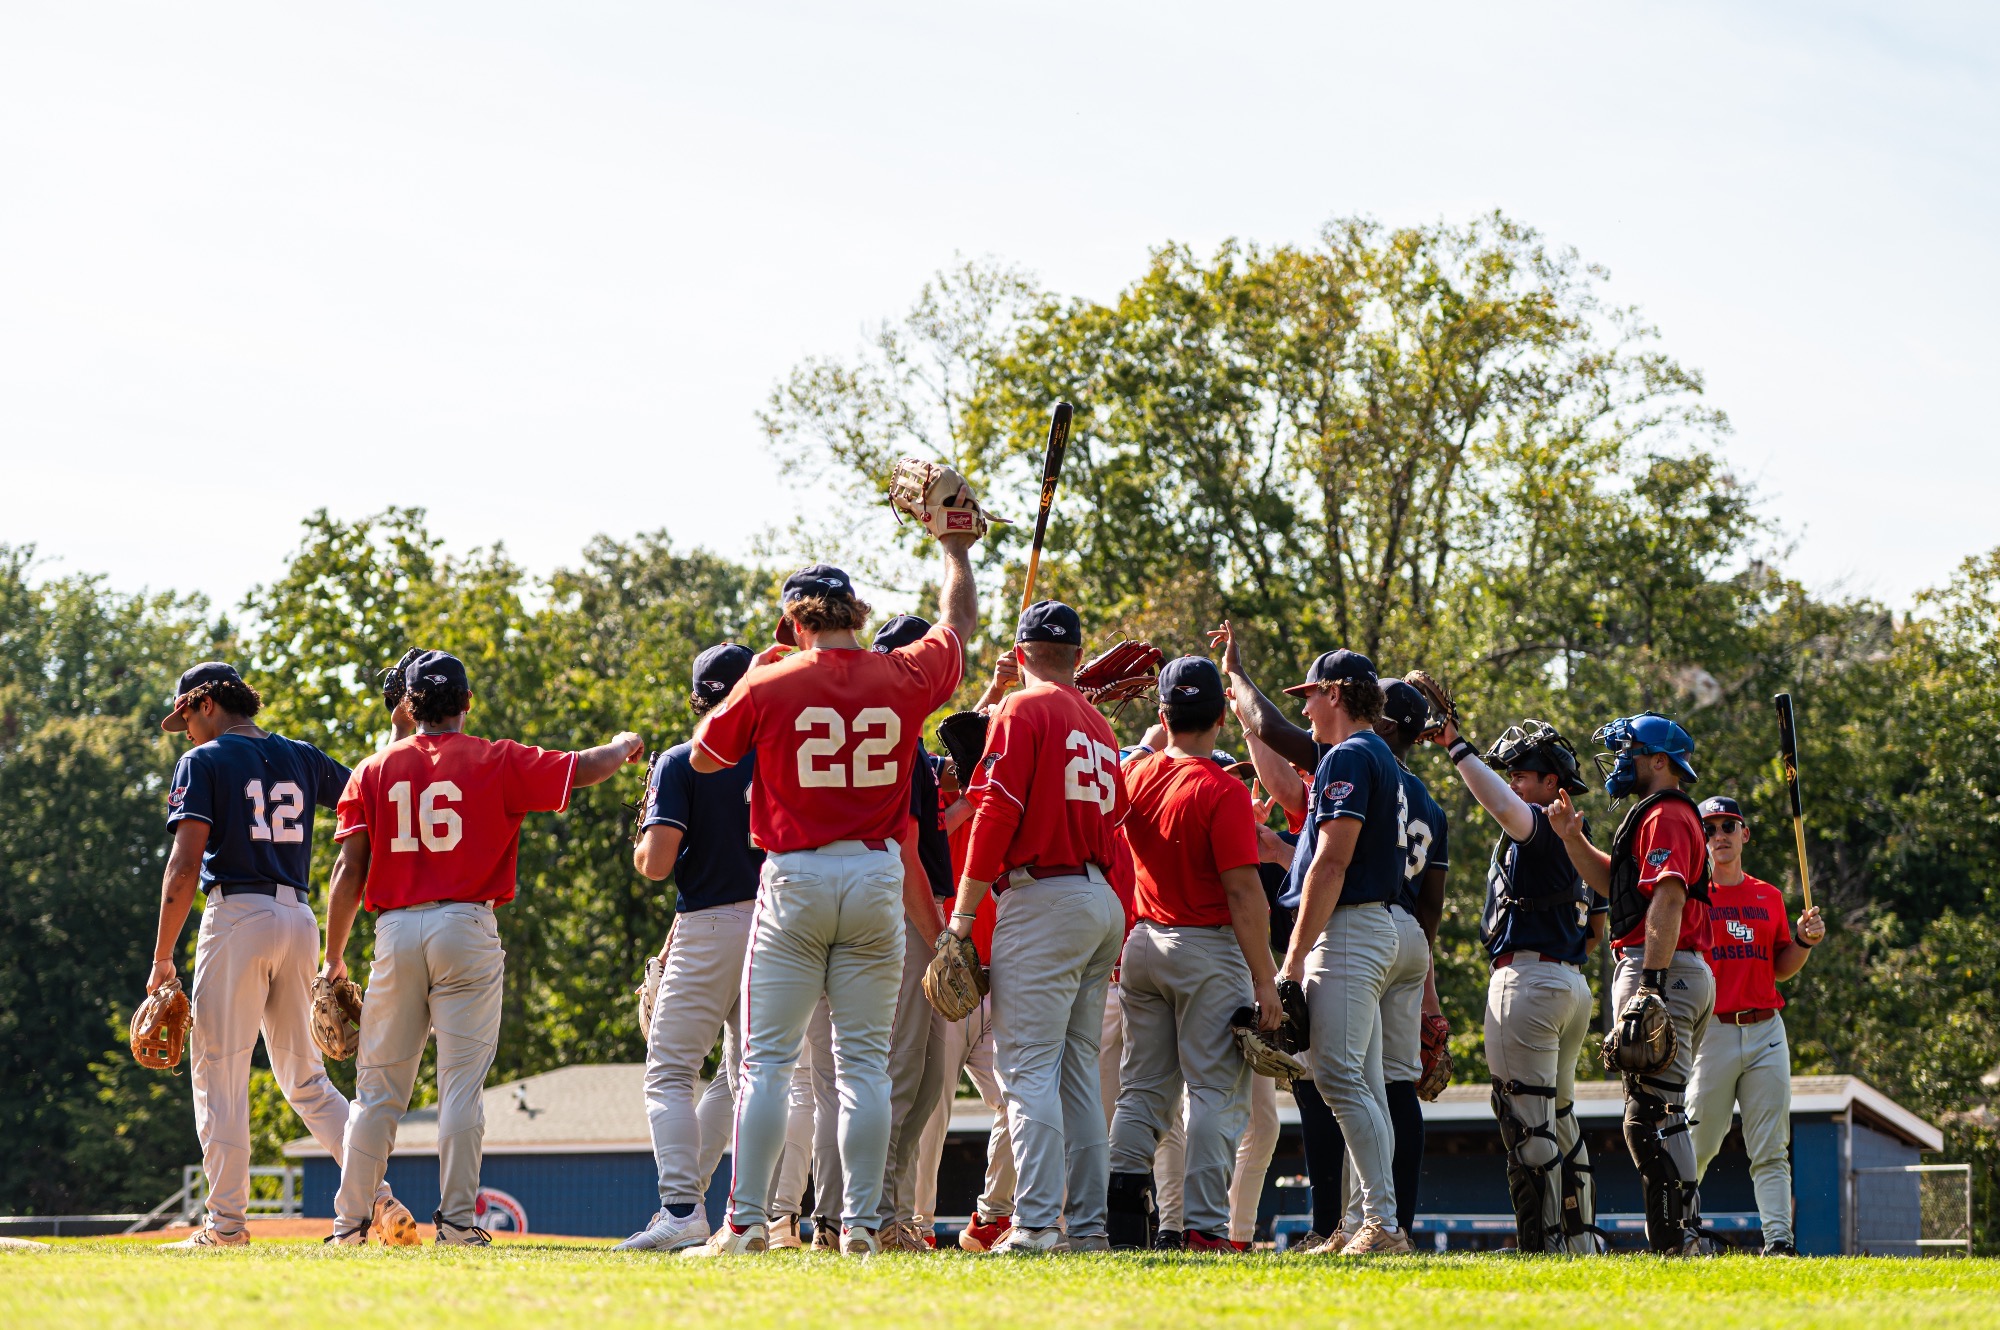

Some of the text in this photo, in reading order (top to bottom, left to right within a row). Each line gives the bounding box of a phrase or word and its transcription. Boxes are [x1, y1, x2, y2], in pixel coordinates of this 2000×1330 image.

[794, 706, 901, 788] 22
[1065, 729, 1117, 816] 25
[244, 778, 304, 844] 12
[387, 780, 463, 853] 16
[1708, 906, 1770, 921] OUTHERN INDIANA
[1726, 920, 1754, 943] USI
[1711, 944, 1769, 961] BASEBALL
